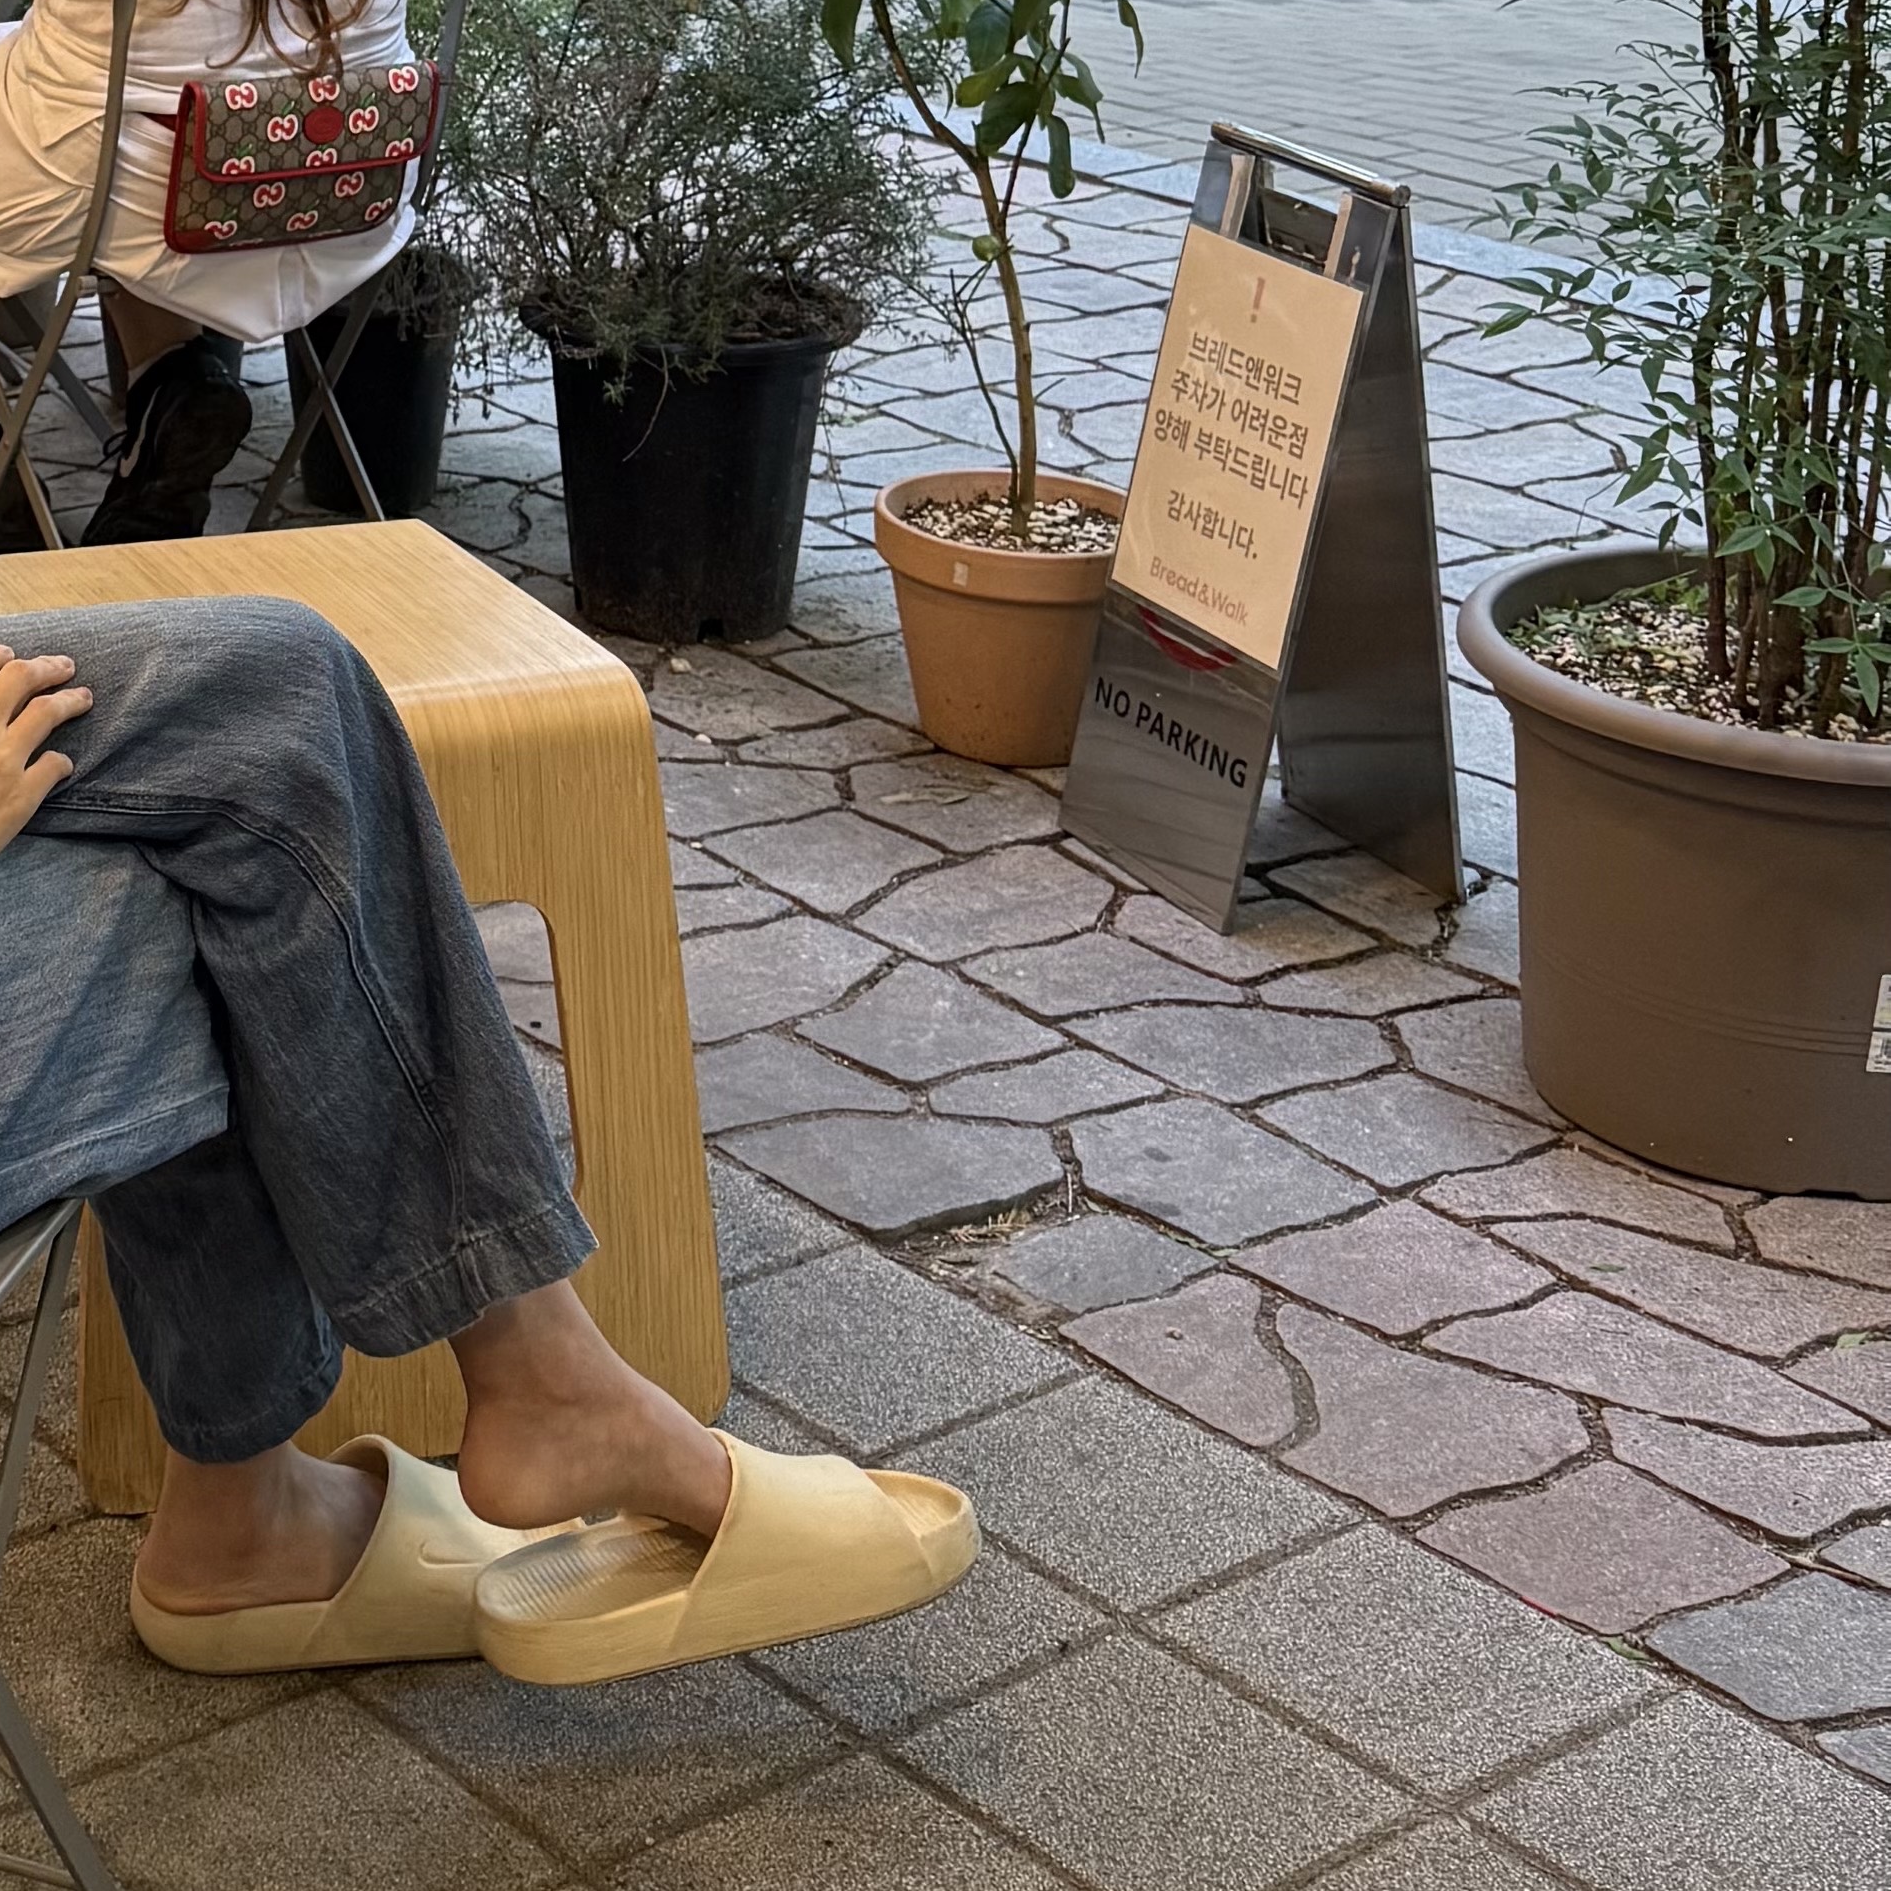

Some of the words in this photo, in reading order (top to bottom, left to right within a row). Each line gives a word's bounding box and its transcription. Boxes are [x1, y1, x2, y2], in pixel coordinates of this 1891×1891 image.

[1188, 331, 1303, 406] 브레드앤워크
[1170, 368, 1227, 422] 주차가
[1230, 397, 1309, 461] 어려운점
[1153, 408, 1192, 453] 양해
[1193, 426, 1309, 510] 부탁드립니다
[1166, 489, 1258, 560] 감사합니다.
[1149, 555, 1249, 627] Bread&Walk
[1094, 676, 1131, 719] NO
[1135, 701, 1249, 789] PARKING
